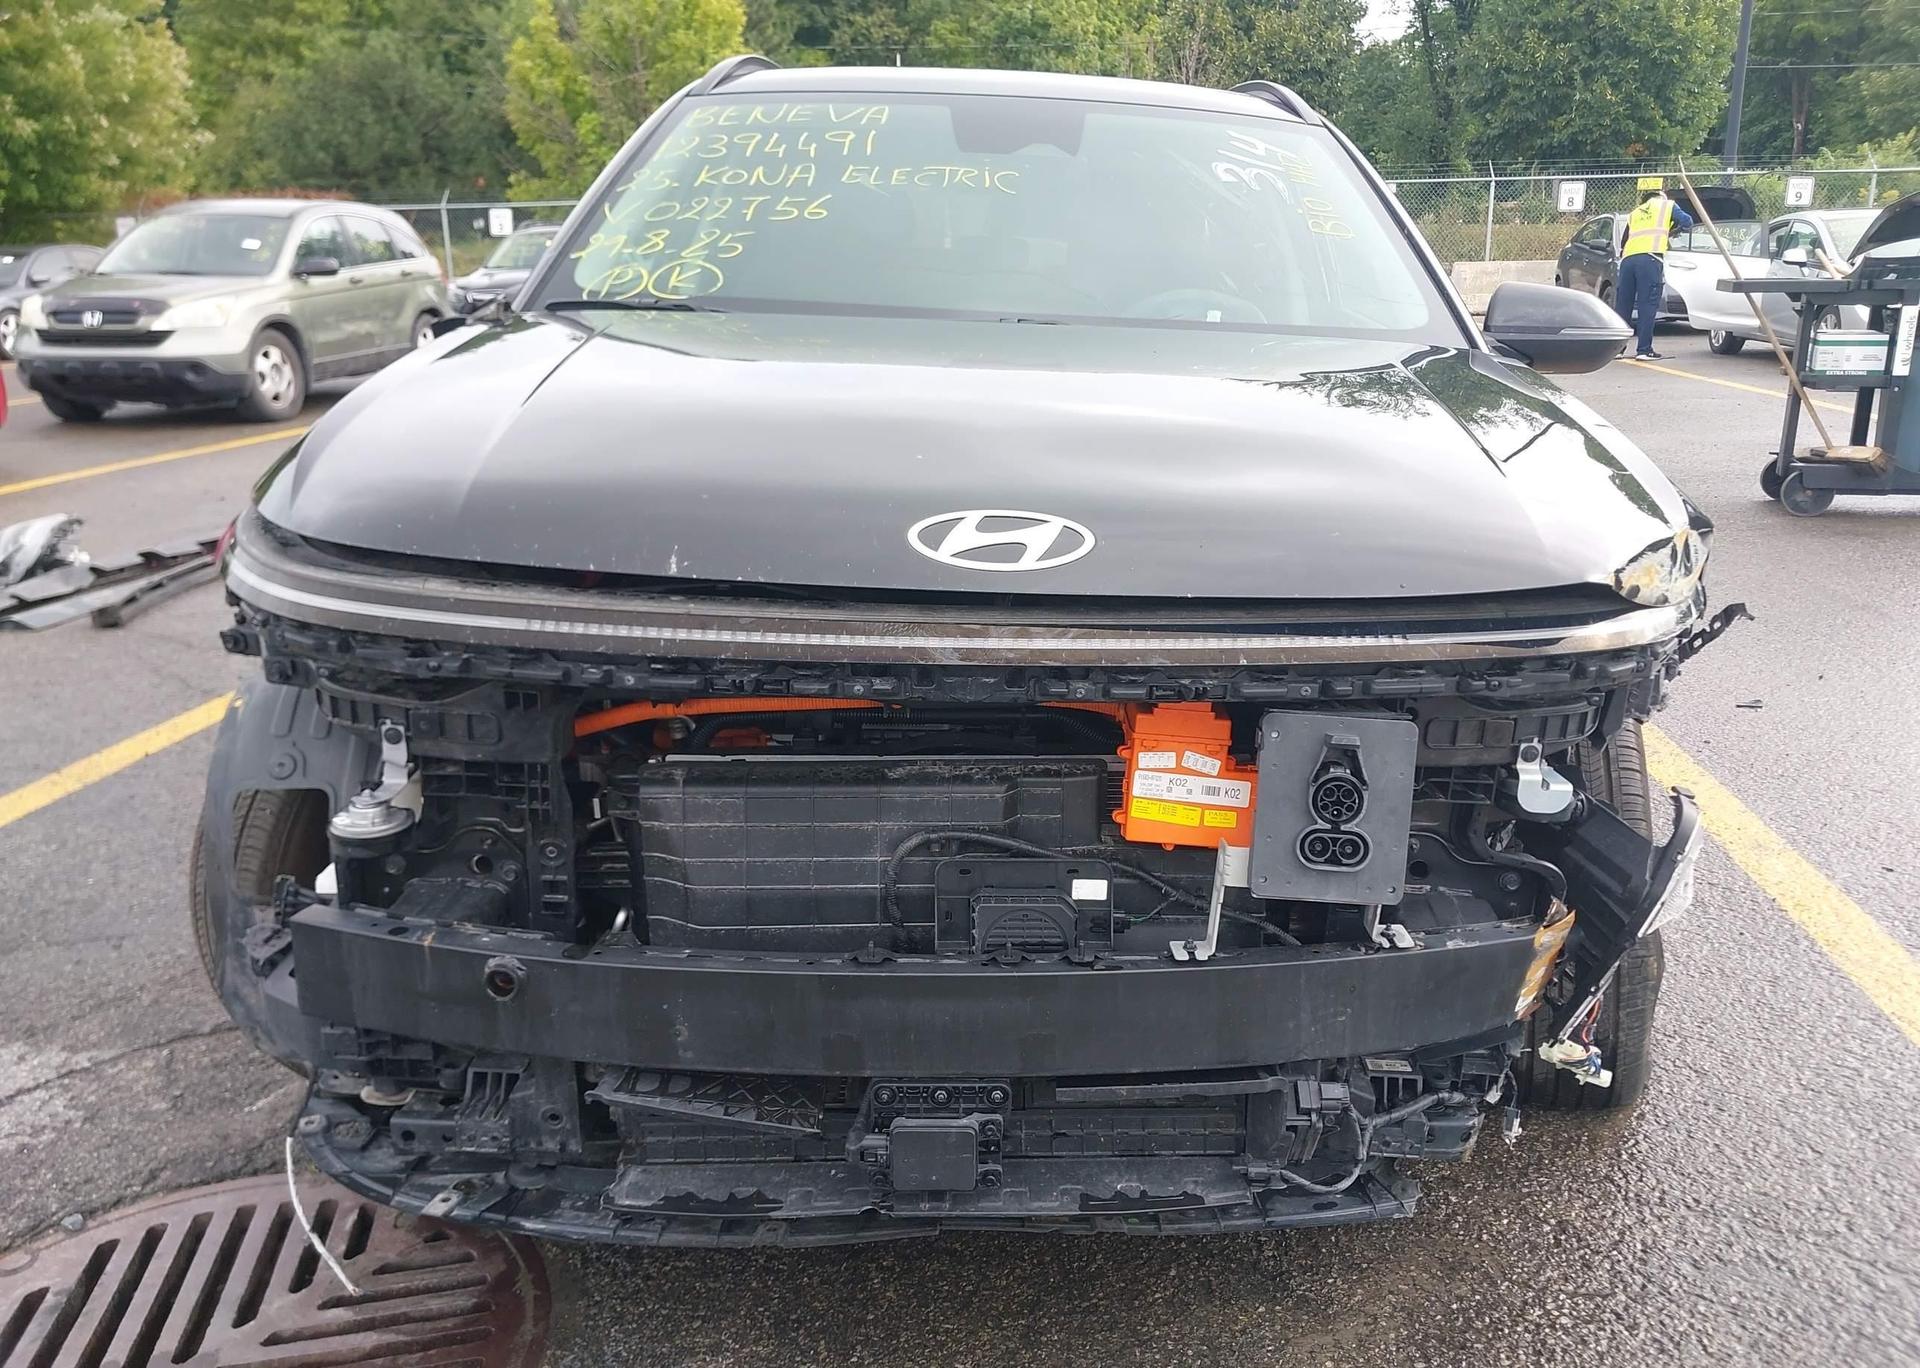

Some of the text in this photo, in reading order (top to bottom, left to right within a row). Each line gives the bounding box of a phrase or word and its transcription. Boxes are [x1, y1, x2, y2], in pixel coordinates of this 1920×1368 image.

[684, 103, 889, 128] BENEVA
[694, 163, 816, 188] KONA
[840, 164, 1020, 195] ELECTRIC
[1567, 196, 1575, 207] 8
[1795, 191, 1803, 203] 9
[1168, 777, 1189, 788] K02
[1224, 787, 1241, 800] K02
